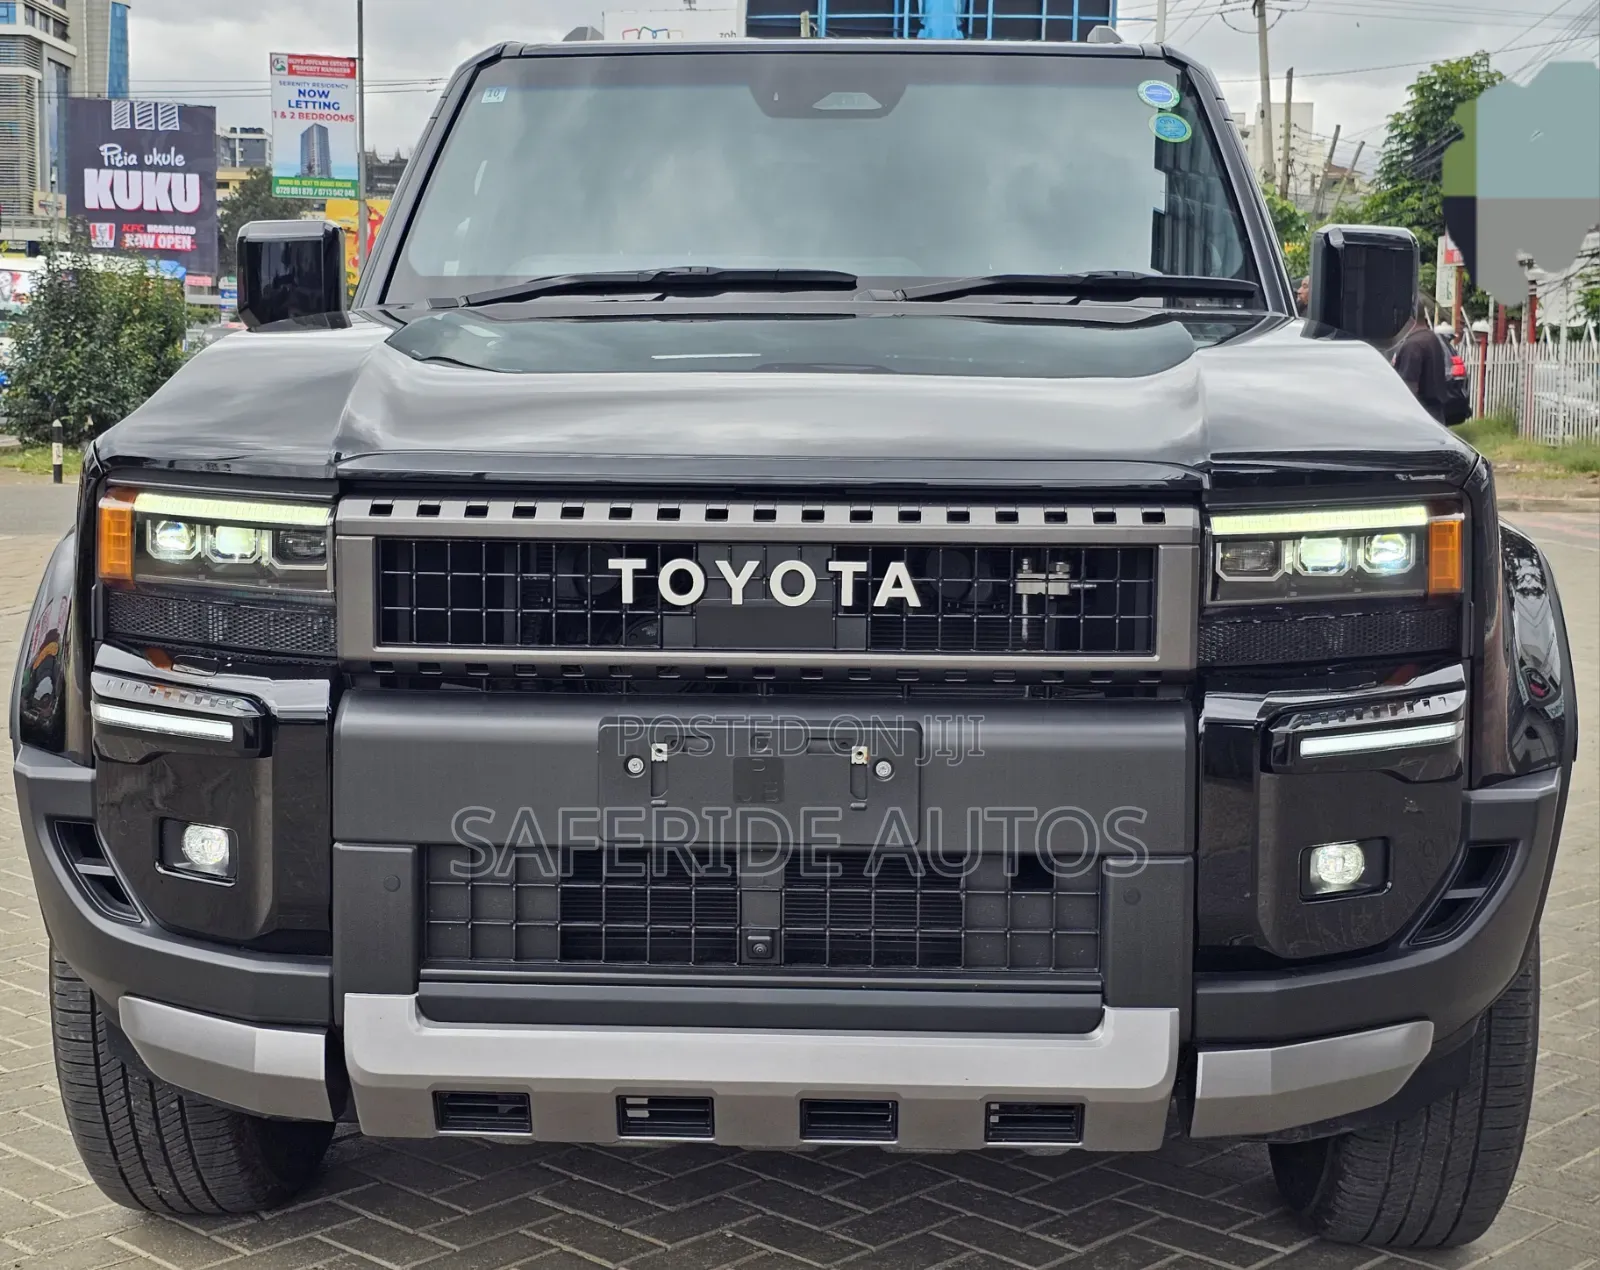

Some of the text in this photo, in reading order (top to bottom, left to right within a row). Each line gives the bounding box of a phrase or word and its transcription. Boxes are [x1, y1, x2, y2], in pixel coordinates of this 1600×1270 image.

[312, 82, 348, 90] RESIDENCY
[298, 89, 330, 99] NOW
[288, 100, 340, 111] LETTING
[273, 111, 277, 119] 1
[280, 111, 286, 119] &
[298, 112, 355, 123] BEDROOMS
[144, 146, 186, 166] ukule
[84, 168, 201, 214] KUKU
[122, 223, 145, 233] KFC
[174, 225, 196, 236] ROAD
[157, 235, 192, 250] OPEN
[608, 558, 921, 608] TOYOTA
